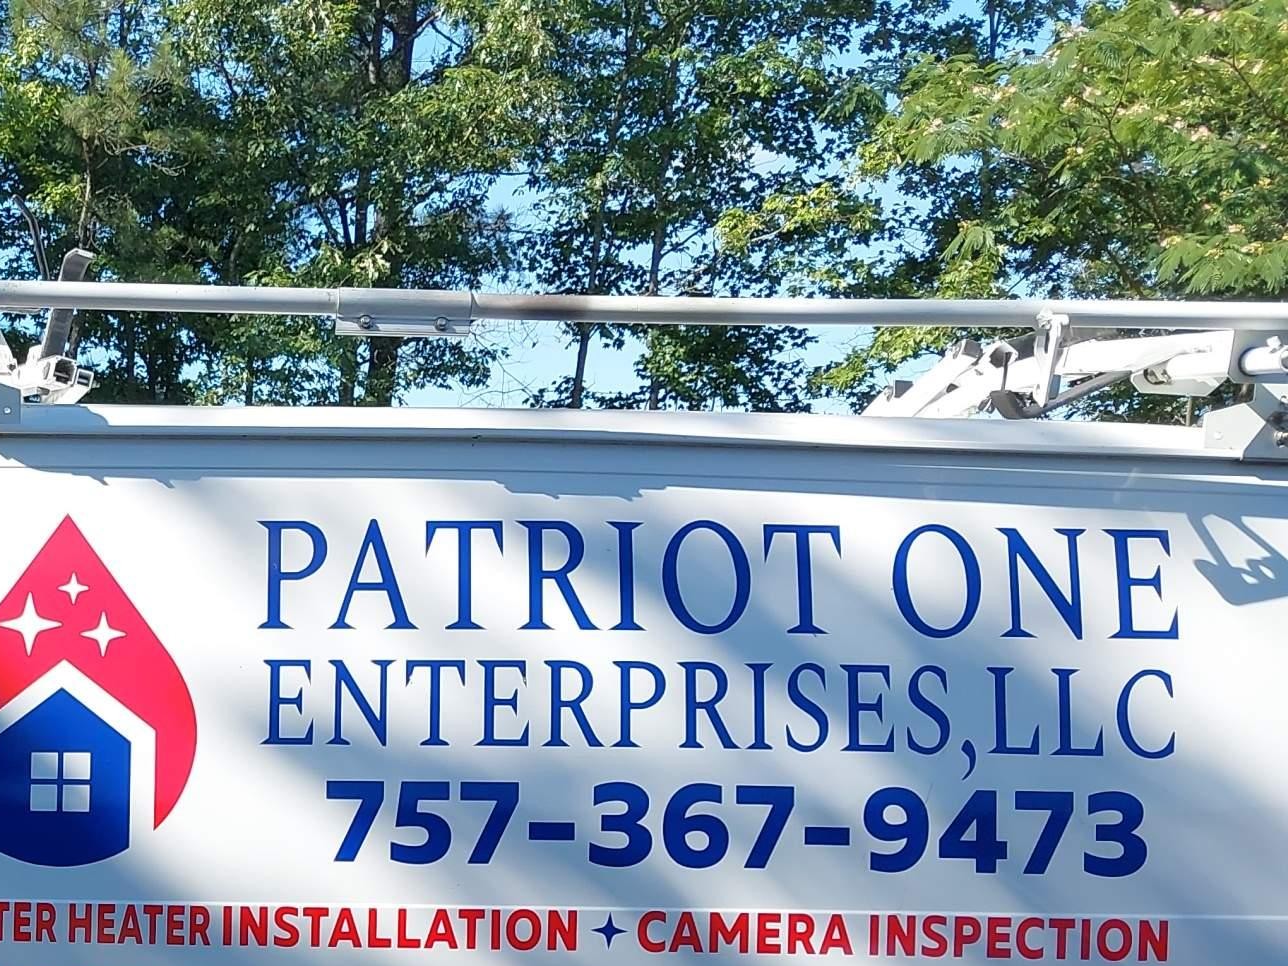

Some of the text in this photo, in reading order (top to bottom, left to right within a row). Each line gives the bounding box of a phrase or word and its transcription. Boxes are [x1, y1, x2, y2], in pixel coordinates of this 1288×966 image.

[257, 518, 1180, 641] PATRIOT ONE
[326, 780, 1149, 878] 757-367-9473
[68, 904, 211, 945] HEATER
[222, 906, 579, 951] INSTALLATION
[636, 911, 853, 955] CAMERA
[869, 915, 1171, 962] INSPECTION
